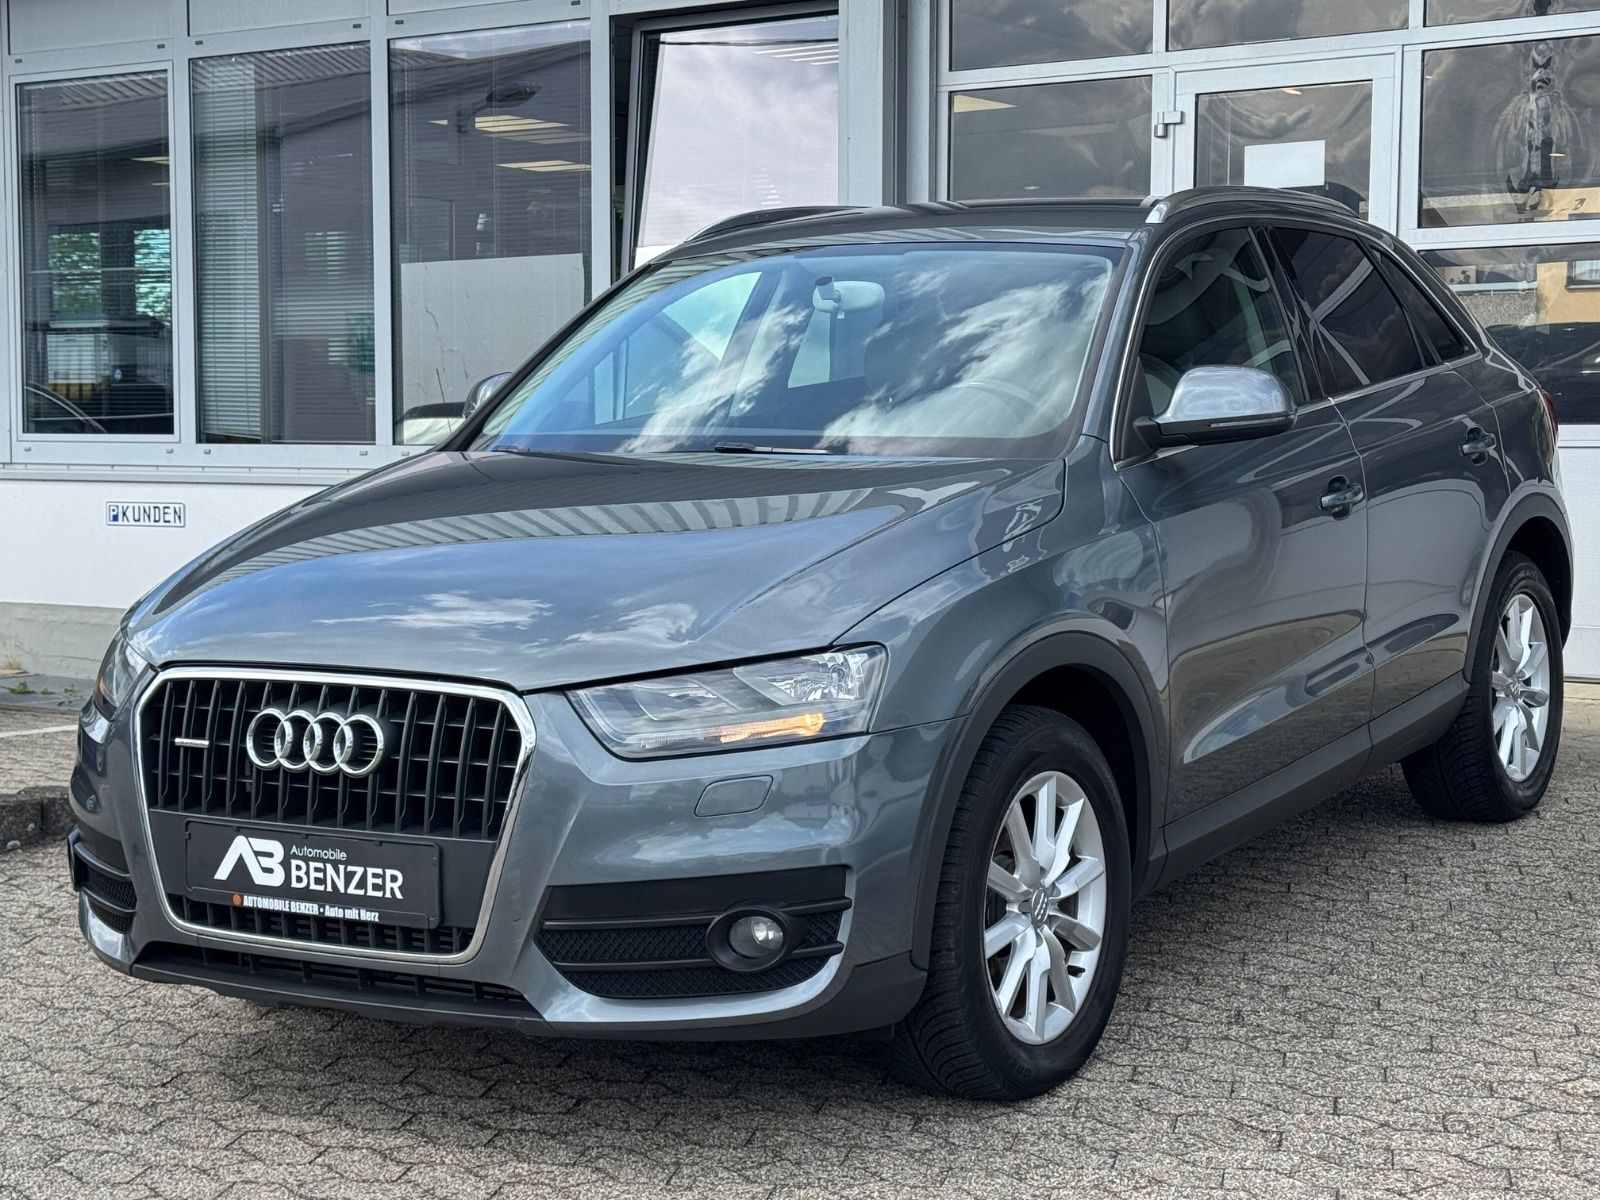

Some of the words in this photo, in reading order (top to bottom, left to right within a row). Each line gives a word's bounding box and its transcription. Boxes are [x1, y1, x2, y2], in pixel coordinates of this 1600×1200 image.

[121, 505, 182, 523] KUNDEN
[290, 844, 347, 861] Automobile
[290, 859, 404, 899] BENZER
[243, 895, 290, 912] AUTOMOBILE
[290, 901, 319, 915] BENZER
[325, 905, 343, 918] Auto
[345, 907, 360, 920] mit
[360, 909, 380, 922] Herz
